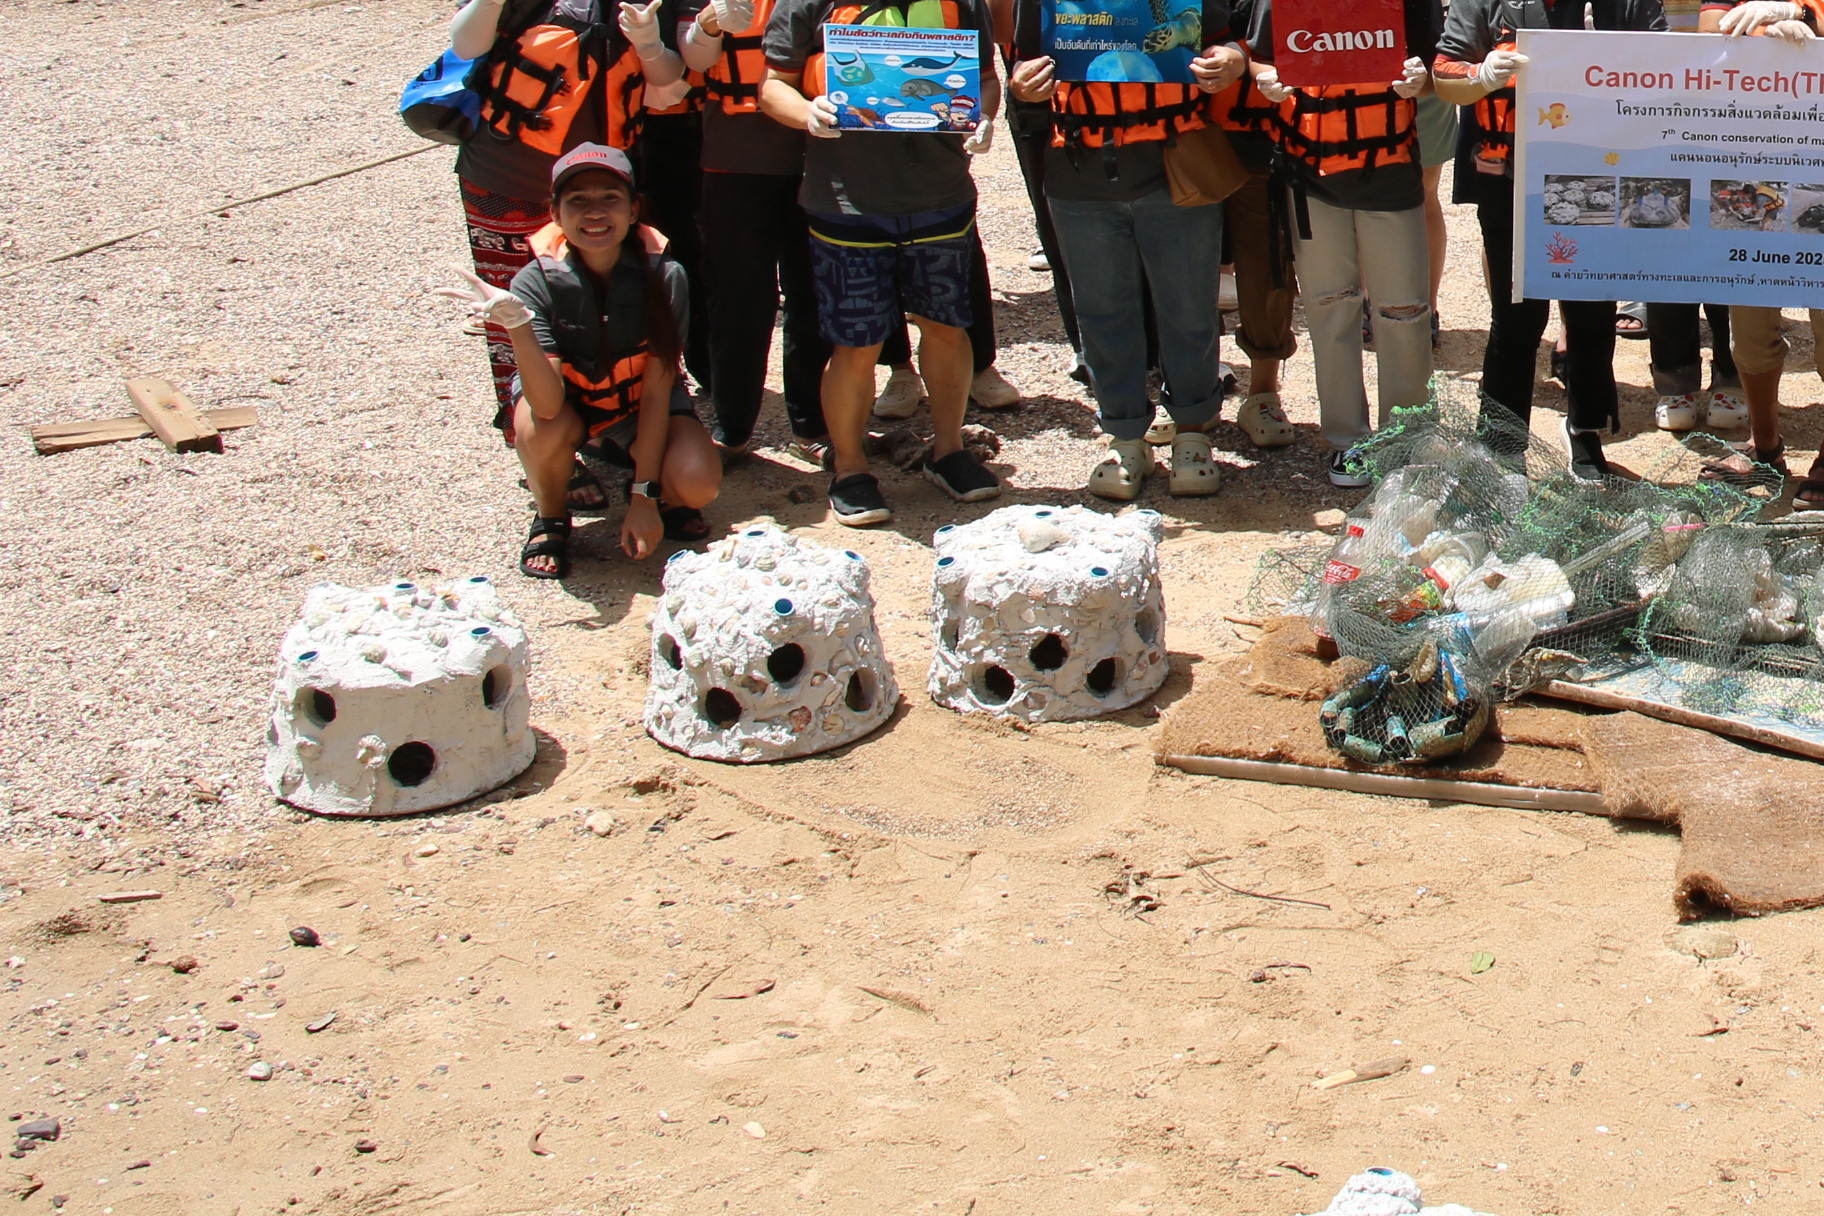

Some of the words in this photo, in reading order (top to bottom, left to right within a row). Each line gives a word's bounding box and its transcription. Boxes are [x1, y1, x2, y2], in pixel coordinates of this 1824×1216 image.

[1055, 11, 1113, 26] ขยะพลาสติก
[1286, 29, 1395, 53] Canon
[1585, 65, 1673, 89] Canon
[1681, 131, 1718, 142] Canon
[1721, 133, 1794, 145] conservation
[1797, 136, 1808, 145] of
[1728, 248, 1748, 262] 28
[1751, 250, 1791, 265] June
